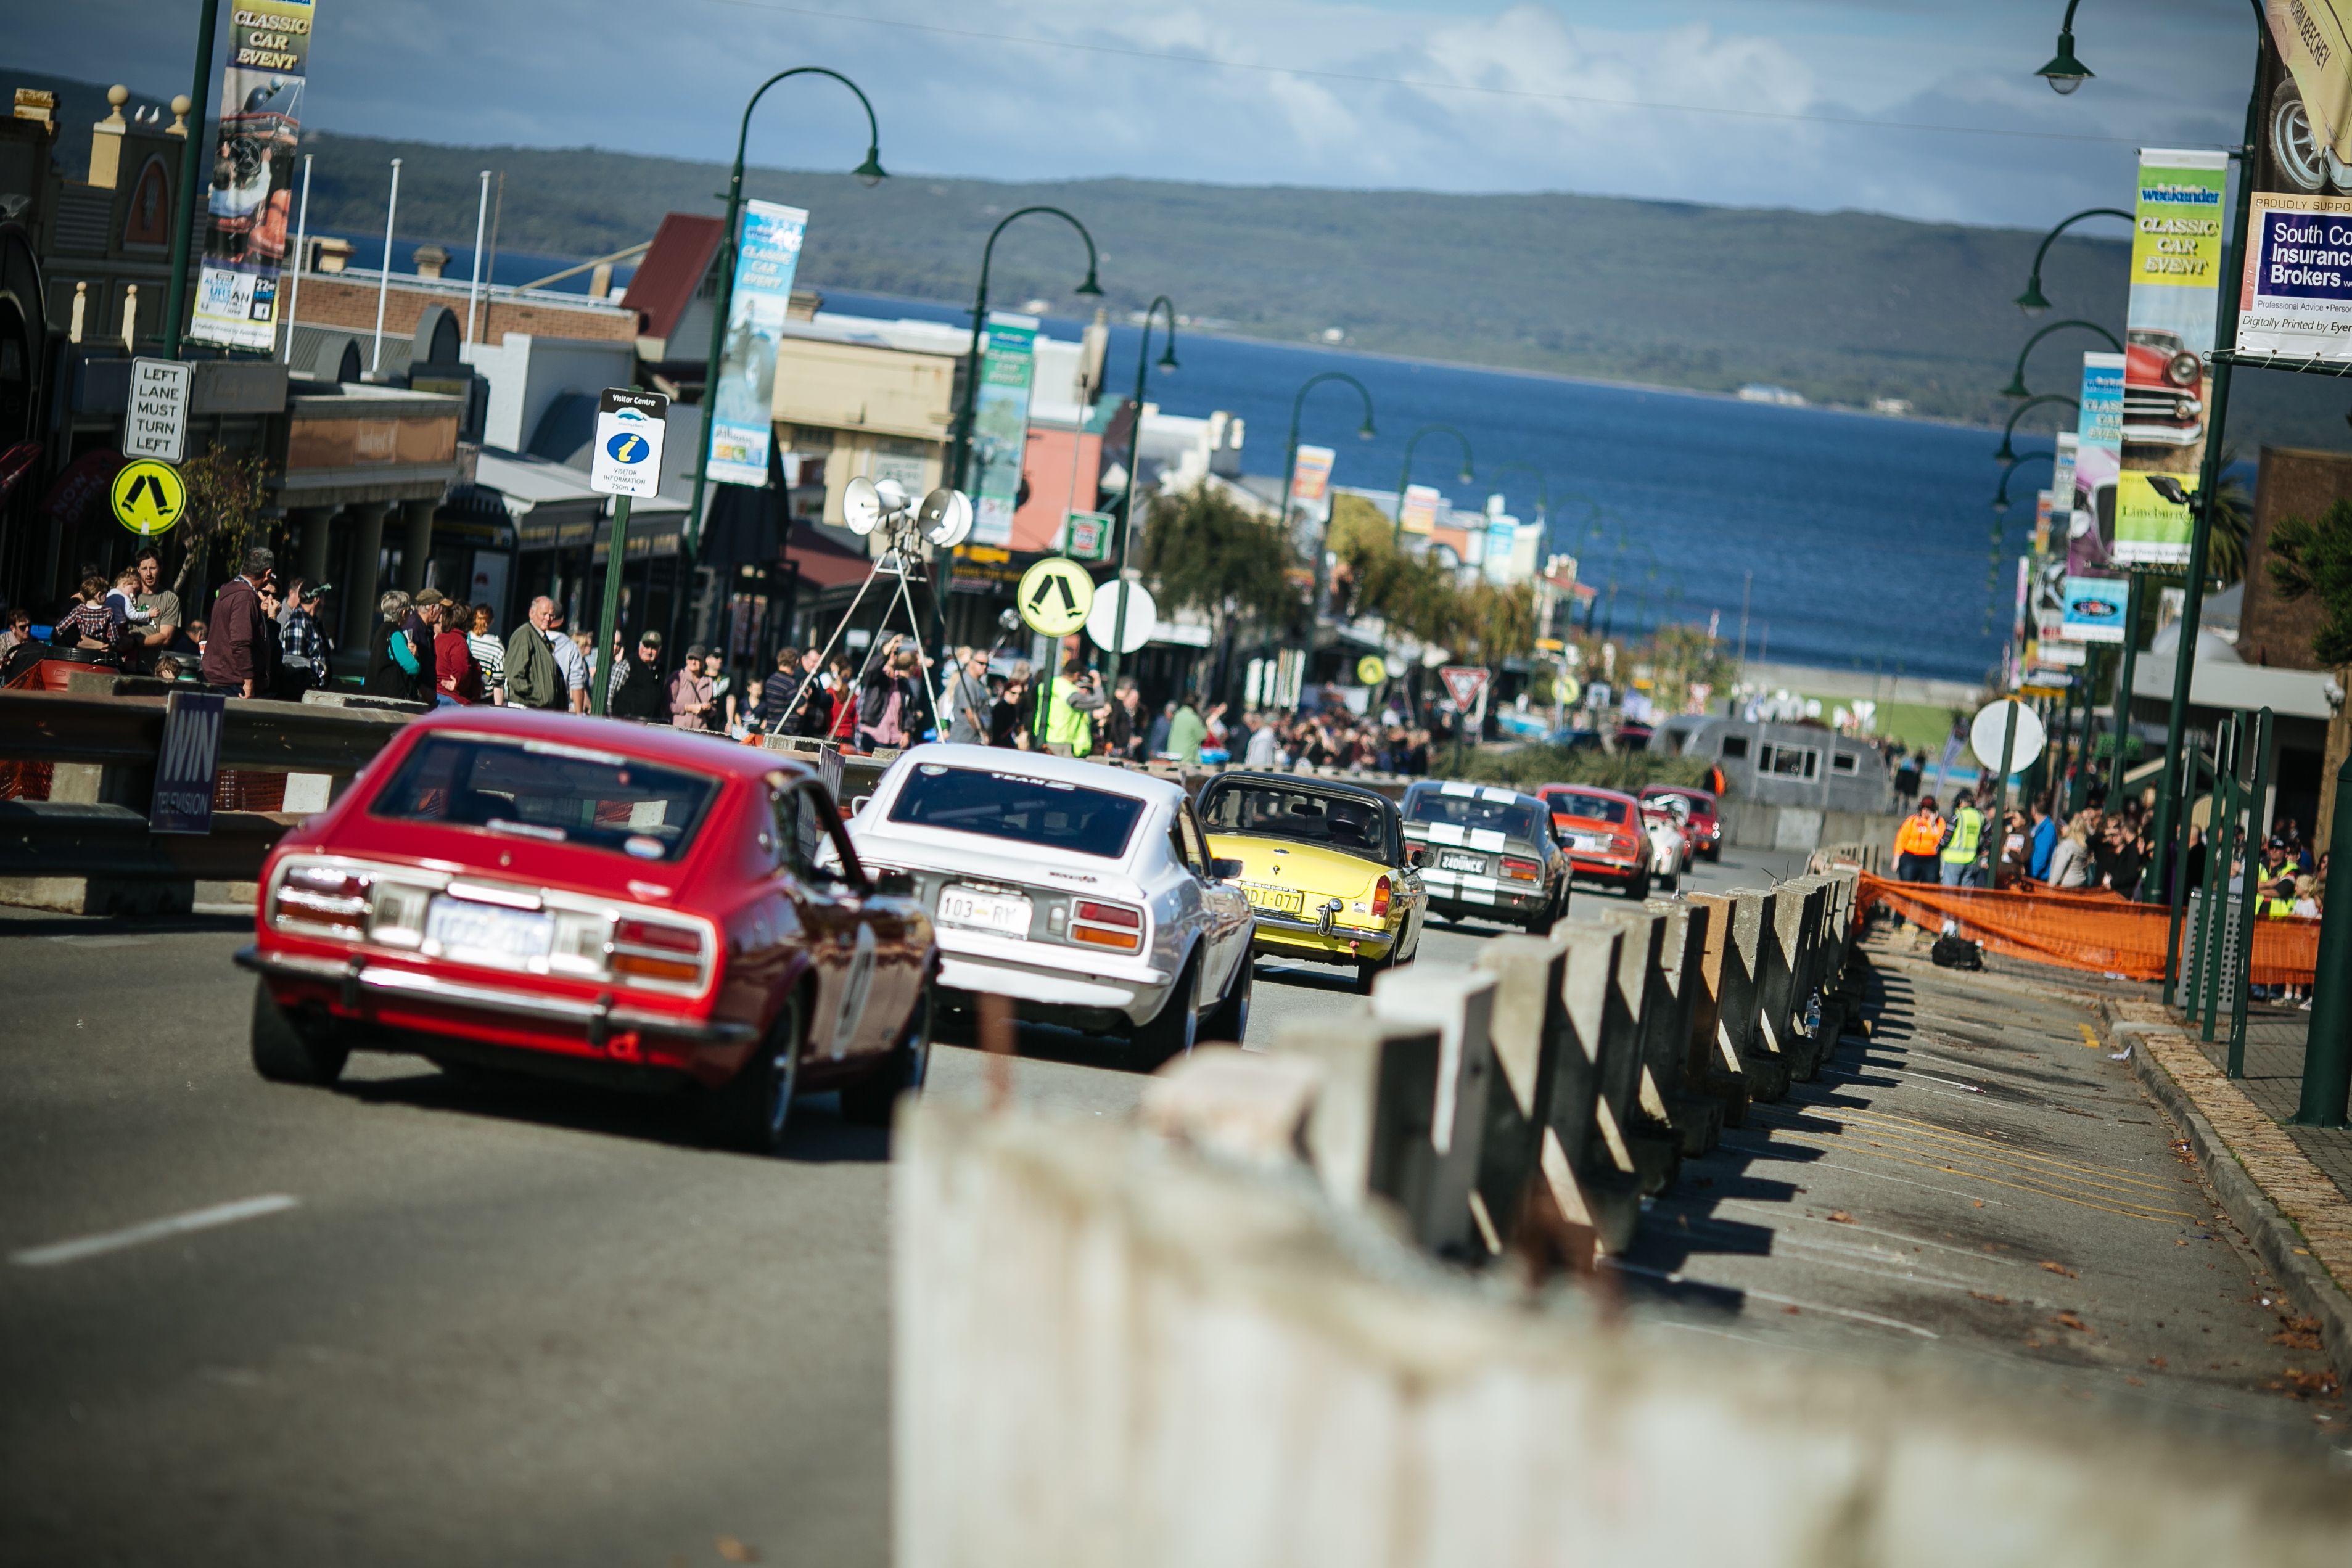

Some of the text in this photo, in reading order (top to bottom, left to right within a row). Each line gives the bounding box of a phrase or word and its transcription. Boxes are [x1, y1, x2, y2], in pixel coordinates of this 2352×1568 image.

[234, 10, 309, 34] CLASSIC
[249, 31, 289, 51] CAR
[2301, 15, 2331, 72] BEECHEY
[236, 48, 298, 70] EVENT
[2256, 199, 2308, 210] PROUDLY
[2140, 217, 2219, 237] CLASSIC
[2274, 222, 2323, 244] South
[2157, 237, 2198, 255] CAR
[2272, 243, 2352, 266] Insuranc
[2144, 256, 2209, 274] EVENT
[2271, 264, 2341, 287] Brokers
[2258, 300, 2299, 310] Professional
[2301, 303, 2324, 311] Advice
[2243, 316, 2280, 330] Digitally
[2282, 319, 2315, 330] Printed
[2317, 321, 2329, 333] by
[144, 367, 178, 383] LEFT
[139, 384, 179, 401] LANE
[612, 394, 656, 406] Visitor Centre
[138, 401, 178, 417] MUST
[136, 418, 175, 435] TURN
[136, 435, 171, 453] LEFT
[604, 475, 646, 485] INFORMATION
[614, 468, 638, 476] VISITOR
[163, 709, 219, 782] WIN
[992, 773, 1045, 786] TEAM
[157, 792, 210, 815] TELEVISION
